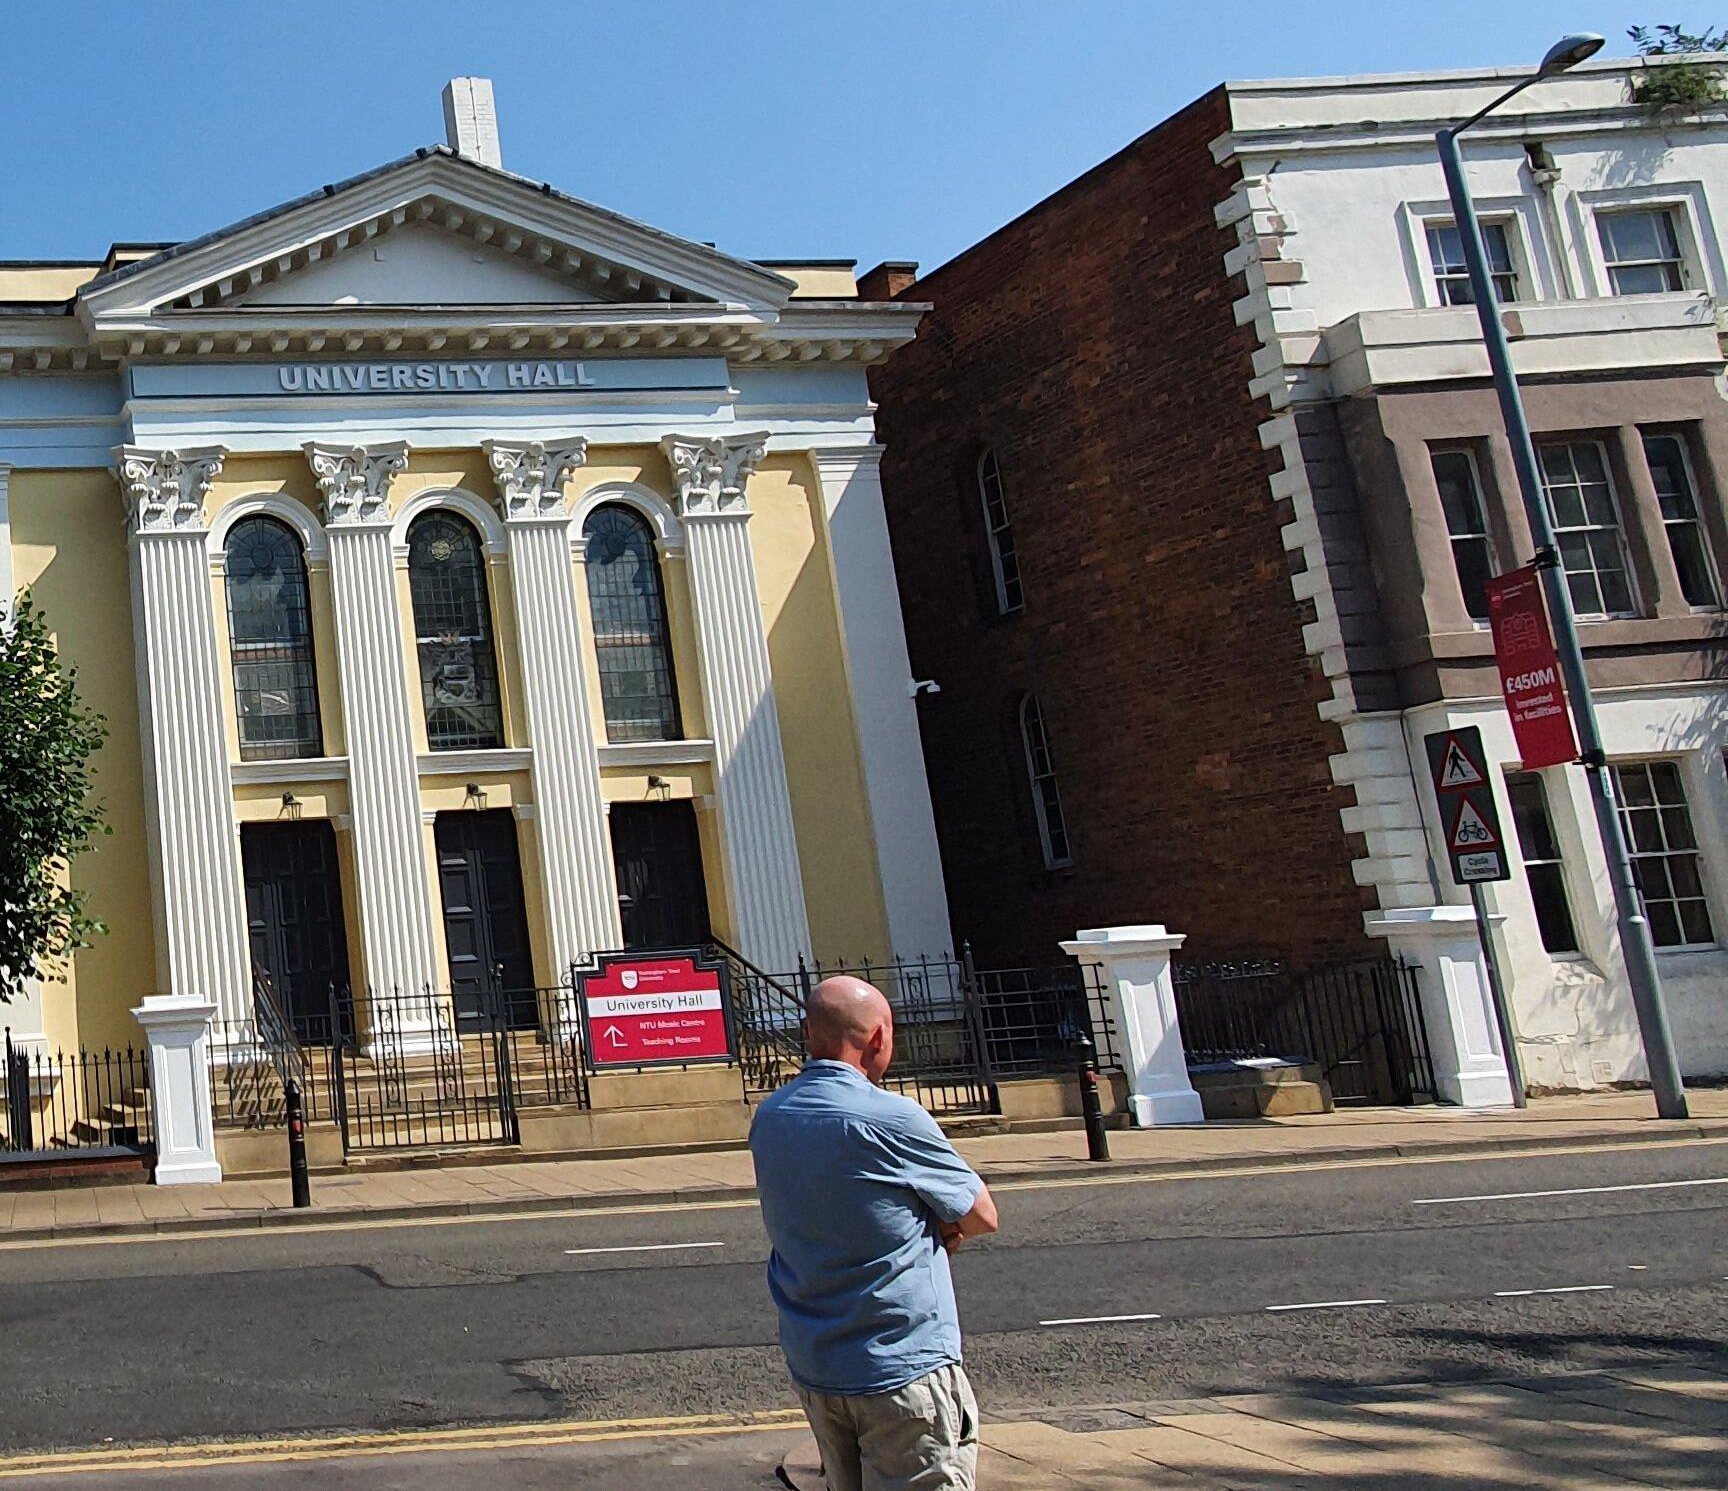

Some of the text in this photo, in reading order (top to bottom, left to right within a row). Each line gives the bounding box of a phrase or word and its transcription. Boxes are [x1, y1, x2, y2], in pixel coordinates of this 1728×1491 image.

[279, 363, 595, 390] UNIVERSITY HALL
[1506, 666, 1556, 694] £450M
[606, 994, 703, 1011] University Hall
